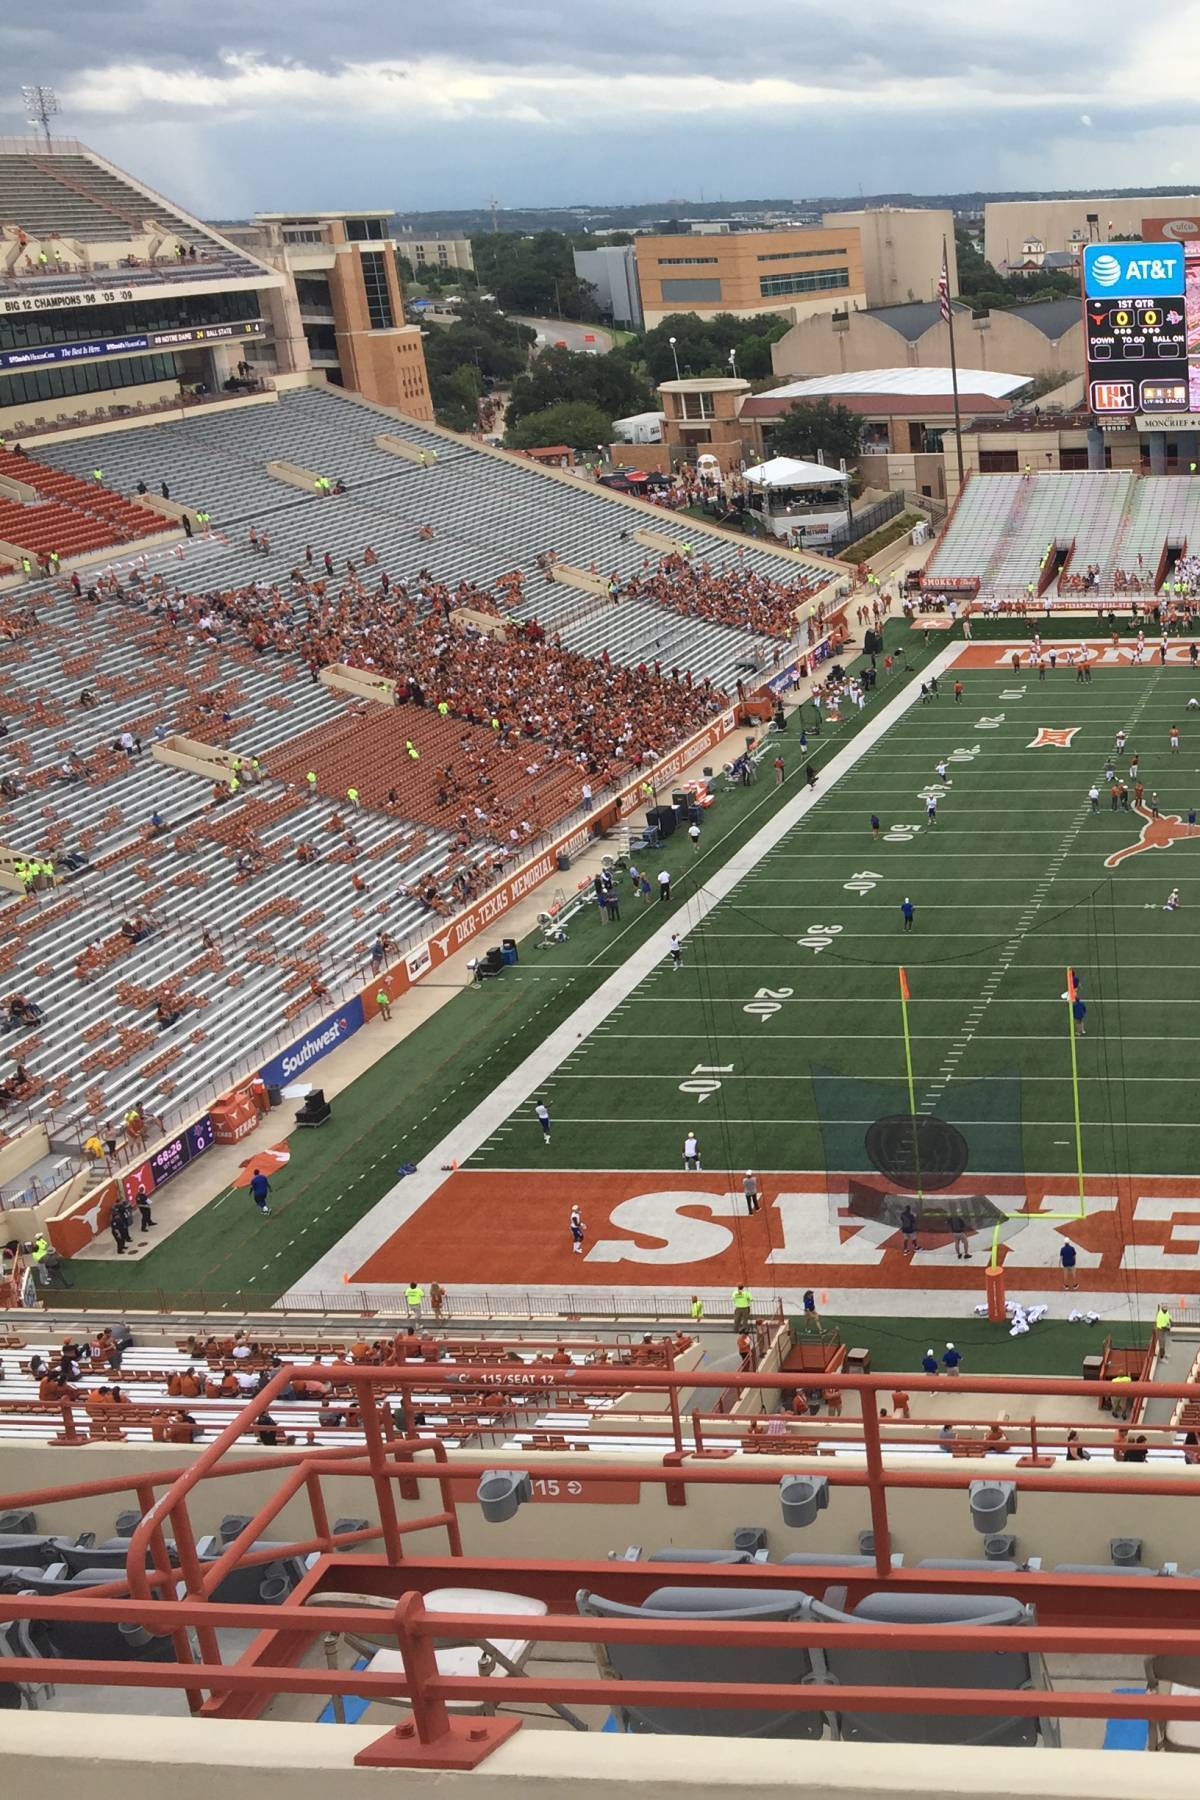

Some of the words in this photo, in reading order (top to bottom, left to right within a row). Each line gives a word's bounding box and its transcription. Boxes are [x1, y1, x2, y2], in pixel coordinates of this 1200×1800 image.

[1126, 260, 1177, 279] AT&T
[5, 300, 20, 311] BIG
[22, 300, 32, 310] 12
[34, 295, 81, 309] CHAMPIONS
[101, 292, 115, 302] '05
[120, 290, 133, 300] '09
[1117, 300, 1132, 308] 1ST
[1135, 300, 1154, 308] QTR
[1116, 311, 1128, 325] 0
[1145, 310, 1156, 325] 0
[162, 334, 178, 343] NOTRE
[178, 332, 192, 341] DAME
[1144, 419, 1188, 428] MONCRIEF
[843, 871, 883, 892] 40
[455, 890, 509, 944] DKR-TEXAS
[511, 855, 554, 900] MEMORIAL
[797, 924, 844, 949] 30
[743, 987, 794, 1016] 20
[281, 1022, 340, 1078] Southwest
[678, 1063, 734, 1095] 10
[233, 1115, 257, 1140] TEXAS
[481, 1374, 534, 1385] 115/SEAT
[540, 1375, 555, 1385] 12
